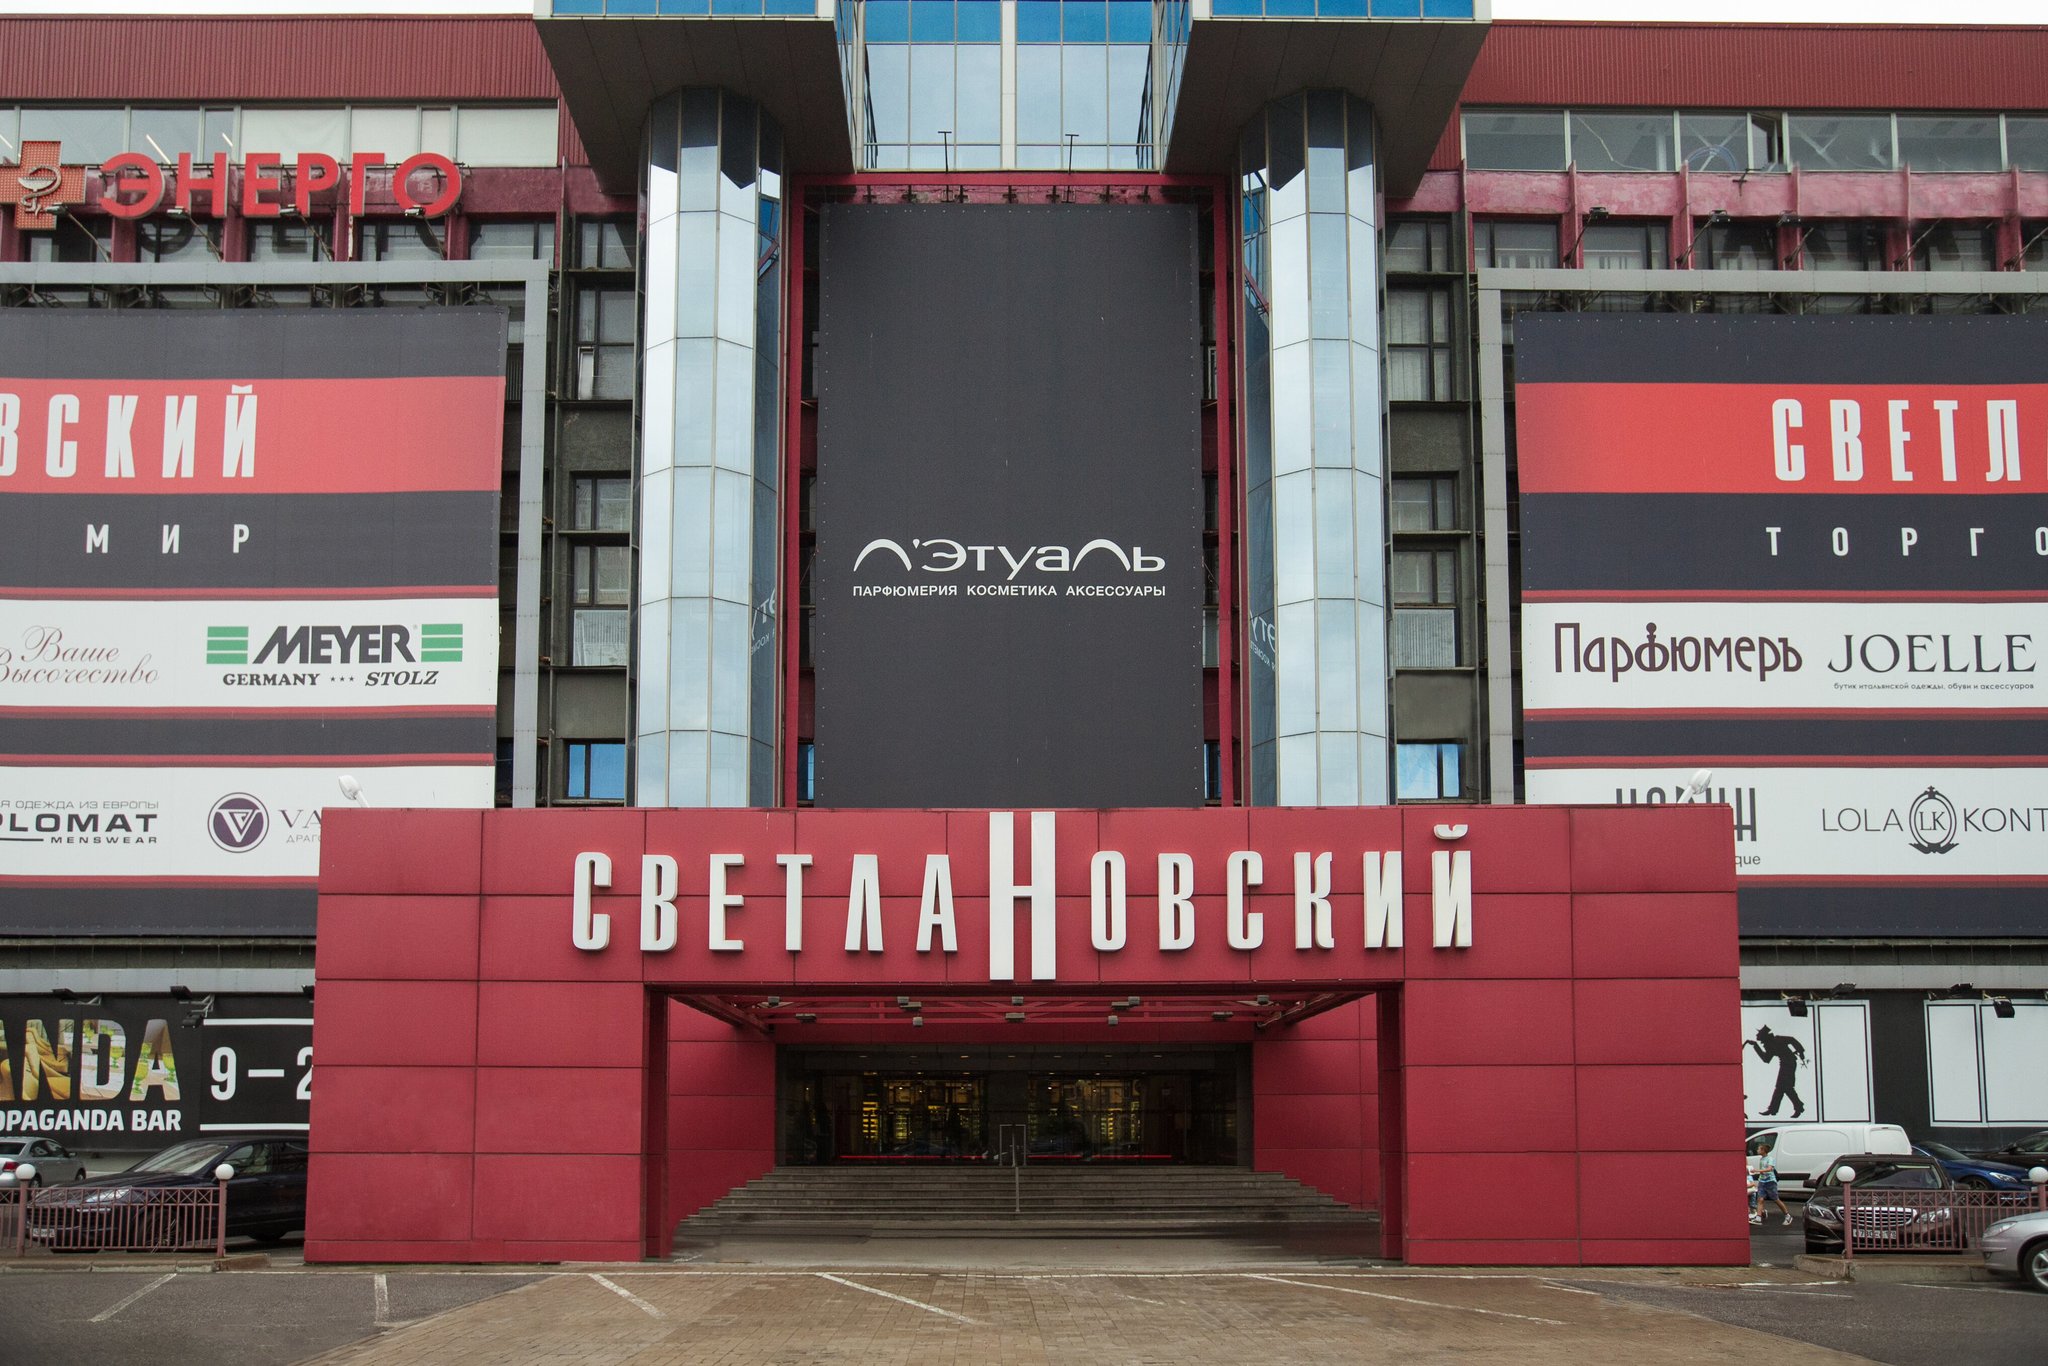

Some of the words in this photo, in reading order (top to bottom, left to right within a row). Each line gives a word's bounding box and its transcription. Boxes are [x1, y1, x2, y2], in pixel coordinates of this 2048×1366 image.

[100, 151, 463, 218] ЭНЕРГО
[1772, 398, 2048, 482] СВЕТЛ
[86, 524, 250, 554] МИР
[1765, 526, 2048, 557] ТОРГО
[853, 585, 958, 597] ПАРФЮМЕРИЯ
[967, 585, 1057, 597] КОСМЕТИКА
[1065, 585, 1166, 597] АКСЕССУАРЫ
[21, 625, 120, 662] Ваше
[252, 625, 416, 664] MEYER
[1554, 622, 1803, 682] Парфюмеръ
[1827, 634, 2037, 673] JOELLE
[222, 673, 321, 686] GERMANY
[365, 671, 439, 686] STOLZ
[1834, 682, 1857, 690] бутик
[1858, 682, 1909, 690] итальянской
[1948, 682, 1971, 690] обуви
[1980, 682, 2034, 690] аксессуаров
[15, 800, 75, 810] ОДЕЖДА
[79, 800, 98, 809] ИЗ
[102, 800, 159, 810] ЕВРОПЫ
[1822, 808, 1903, 831] LOLA
[1919, 812, 1947, 831] LK
[0, 813, 157, 832] LOMAT
[51, 836, 157, 844] MENSWEAR
[286, 834, 321, 843] ДРАГ
[572, 811, 1474, 982] СВЕТЛАНОВСКИЙ
[0, 1019, 181, 1101] NDA
[131, 1110, 181, 1131] BAR
